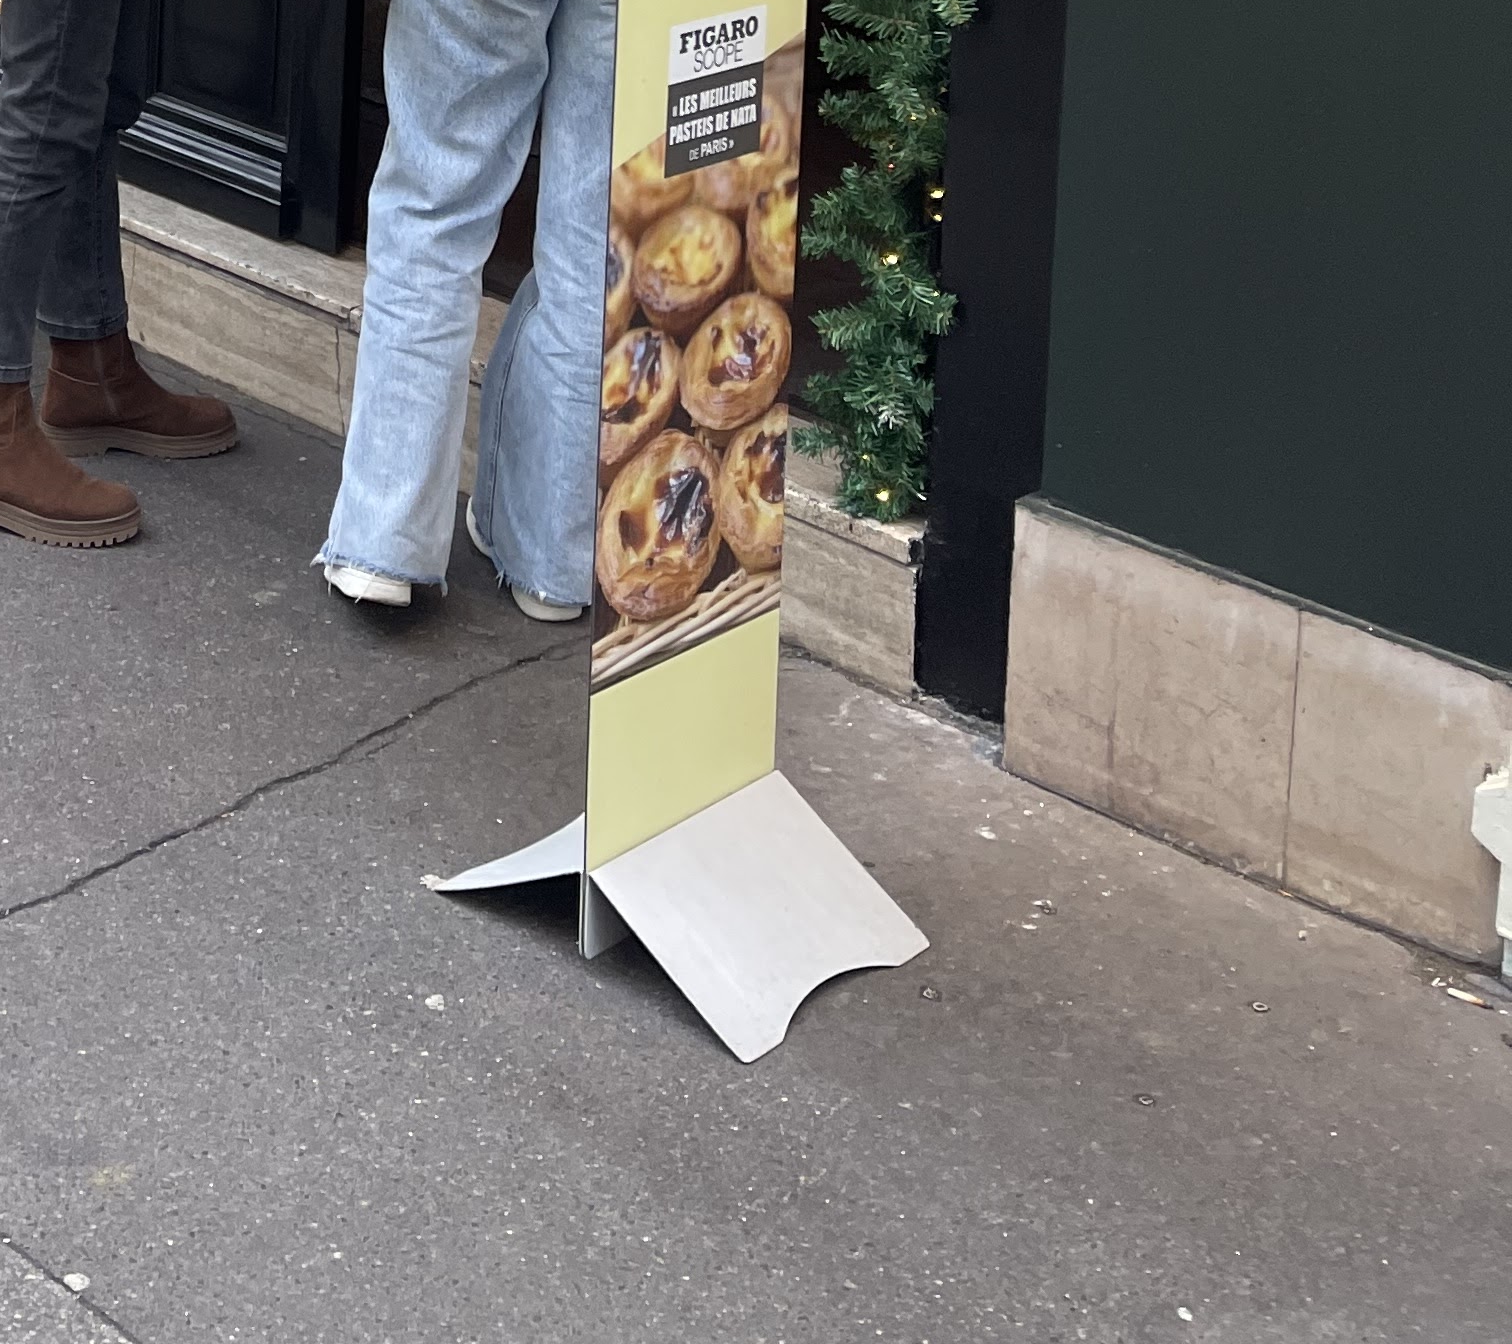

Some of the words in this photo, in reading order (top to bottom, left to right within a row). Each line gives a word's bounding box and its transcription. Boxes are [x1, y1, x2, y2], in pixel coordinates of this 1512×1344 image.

[679, 15, 759, 54] FIGARO
[693, 40, 744, 73] SCOPE
[679, 93, 698, 117] LES
[699, 77, 757, 110] MEILLEURS
[669, 115, 714, 146] PASTEIS
[715, 111, 729, 133] DE
[730, 103, 757, 129] NATA
[700, 137, 728, 158] PARIS
